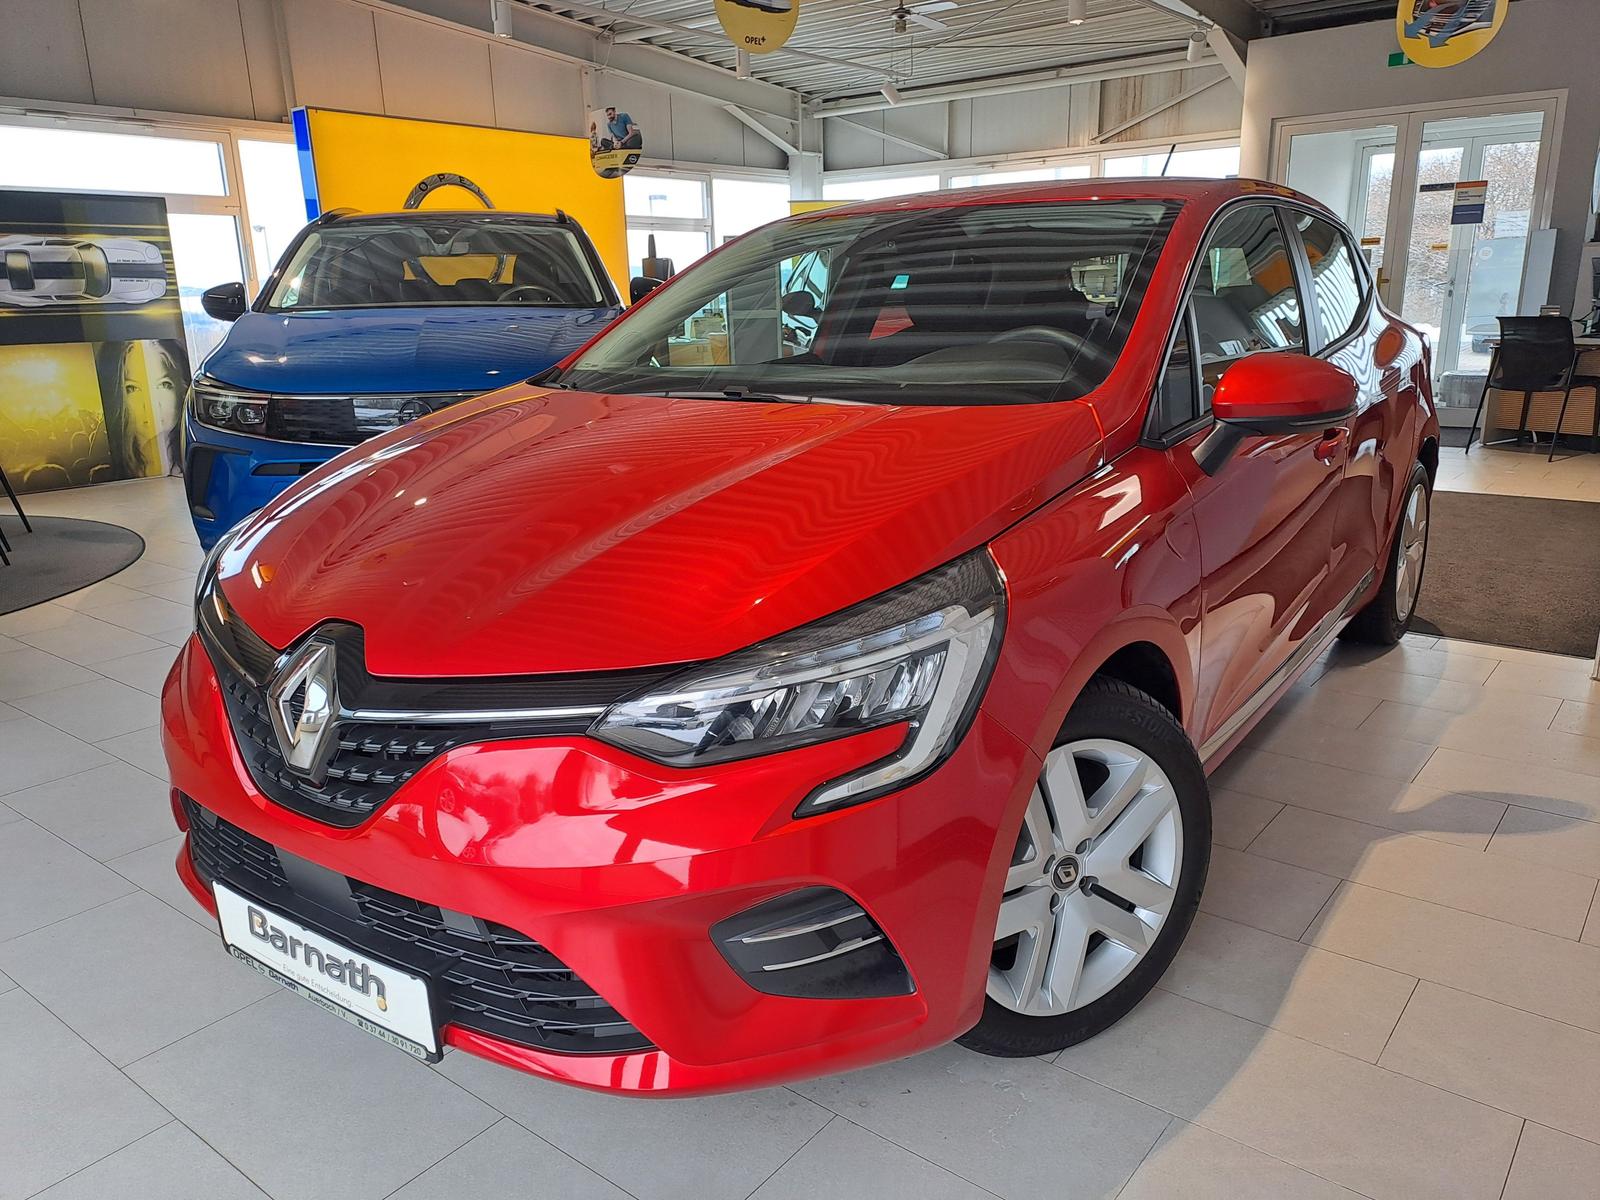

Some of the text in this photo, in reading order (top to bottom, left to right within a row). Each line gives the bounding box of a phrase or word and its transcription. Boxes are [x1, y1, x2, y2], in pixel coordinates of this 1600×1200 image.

[418, 173, 485, 198] OPEL
[233, 947, 298, 992] OPEL Barnath
[247, 905, 387, 1011] Barnath
